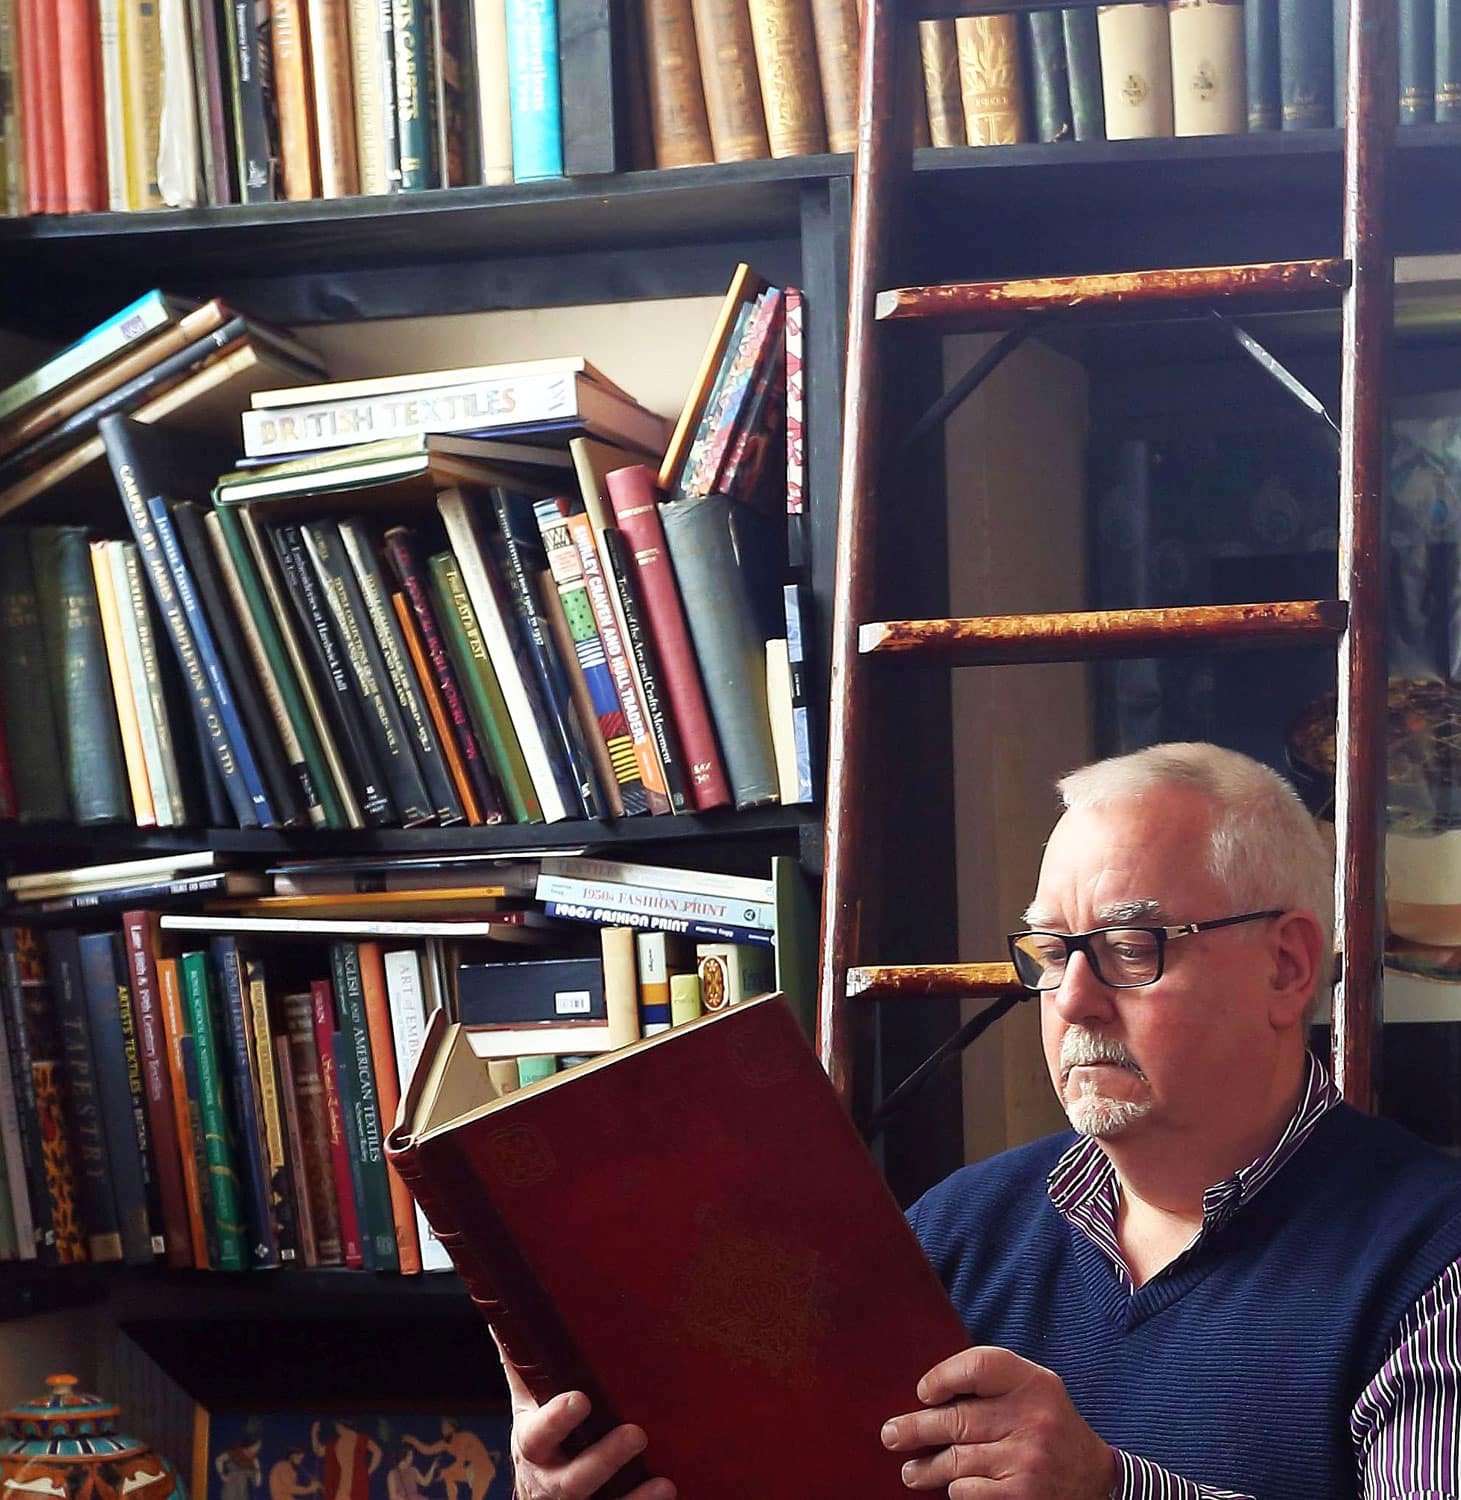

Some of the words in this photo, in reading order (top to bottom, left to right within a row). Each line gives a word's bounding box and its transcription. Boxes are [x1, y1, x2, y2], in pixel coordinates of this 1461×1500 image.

[259, 410, 374, 445] BRITISH
[388, 387, 516, 427] TEXTILES
[116, 461, 151, 530] CARPETS
[140, 530, 159, 553] BY
[506, 539, 522, 572] TEXTILES
[571, 523, 599, 577] SHIRLEY
[149, 556, 175, 602] JAMES
[587, 575, 615, 626] CRAVEN
[290, 544, 320, 609] Embroideries
[315, 620, 339, 667] Hardwick
[330, 668, 347, 691] Hall
[453, 592, 473, 623] EAST
[465, 628, 487, 662] WEST
[603, 626, 623, 656] AND
[166, 606, 206, 690] TEMPLETON
[344, 607, 368, 663] COLLECTIONS
[371, 694, 388, 725] WORLD
[611, 654, 634, 690] HULL
[615, 575, 633, 614] Textiles
[631, 639, 646, 665] Arts
[642, 682, 658, 712] Crafts
[650, 711, 672, 765] Movement
[621, 688, 651, 745] TRADERS
[553, 902, 592, 919] 1960s
[593, 907, 649, 928] FASHION
[649, 916, 688, 933] PRINT
[582, 887, 615, 902] 1950s
[618, 891, 679, 911] FASHION
[681, 899, 726, 917] PRINT
[342, 947, 358, 997] NGLISH
[399, 964, 414, 994] ART
[141, 1014, 157, 1058] Century
[124, 1038, 140, 1095] TEXTILES
[147, 1058, 163, 1101] Textiles
[352, 1026, 372, 1100] AMERICAN
[361, 1103, 381, 1163] TEXTILES
